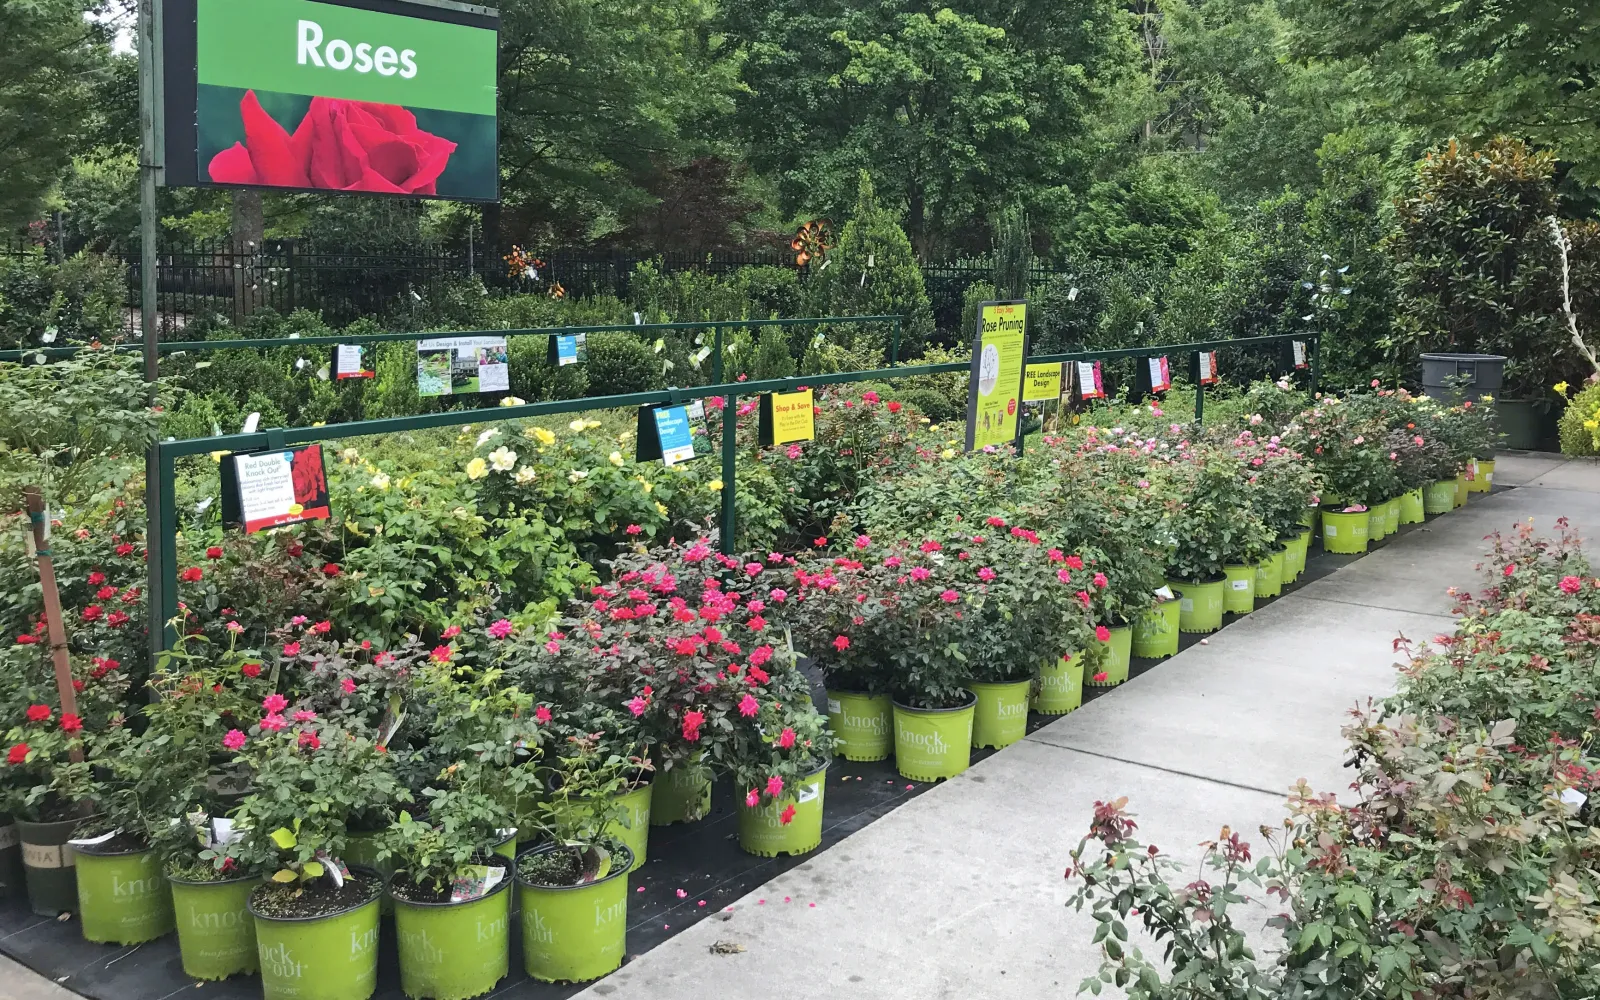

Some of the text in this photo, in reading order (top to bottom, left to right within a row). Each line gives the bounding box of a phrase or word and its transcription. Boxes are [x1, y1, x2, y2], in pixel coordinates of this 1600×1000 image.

[297, 19, 418, 79] Roses
[982, 315, 1024, 334] Rose Pruning
[1025, 370, 1036, 379] REE
[1033, 379, 1050, 388] Design
[775, 402, 811, 413] Shop & Save
[244, 457, 281, 470] Red Double
[245, 469, 265, 478] Knock
[843, 710, 888, 728] knock
[899, 721, 944, 746] knock
[926, 742, 948, 755] out
[273, 959, 303, 978] out
